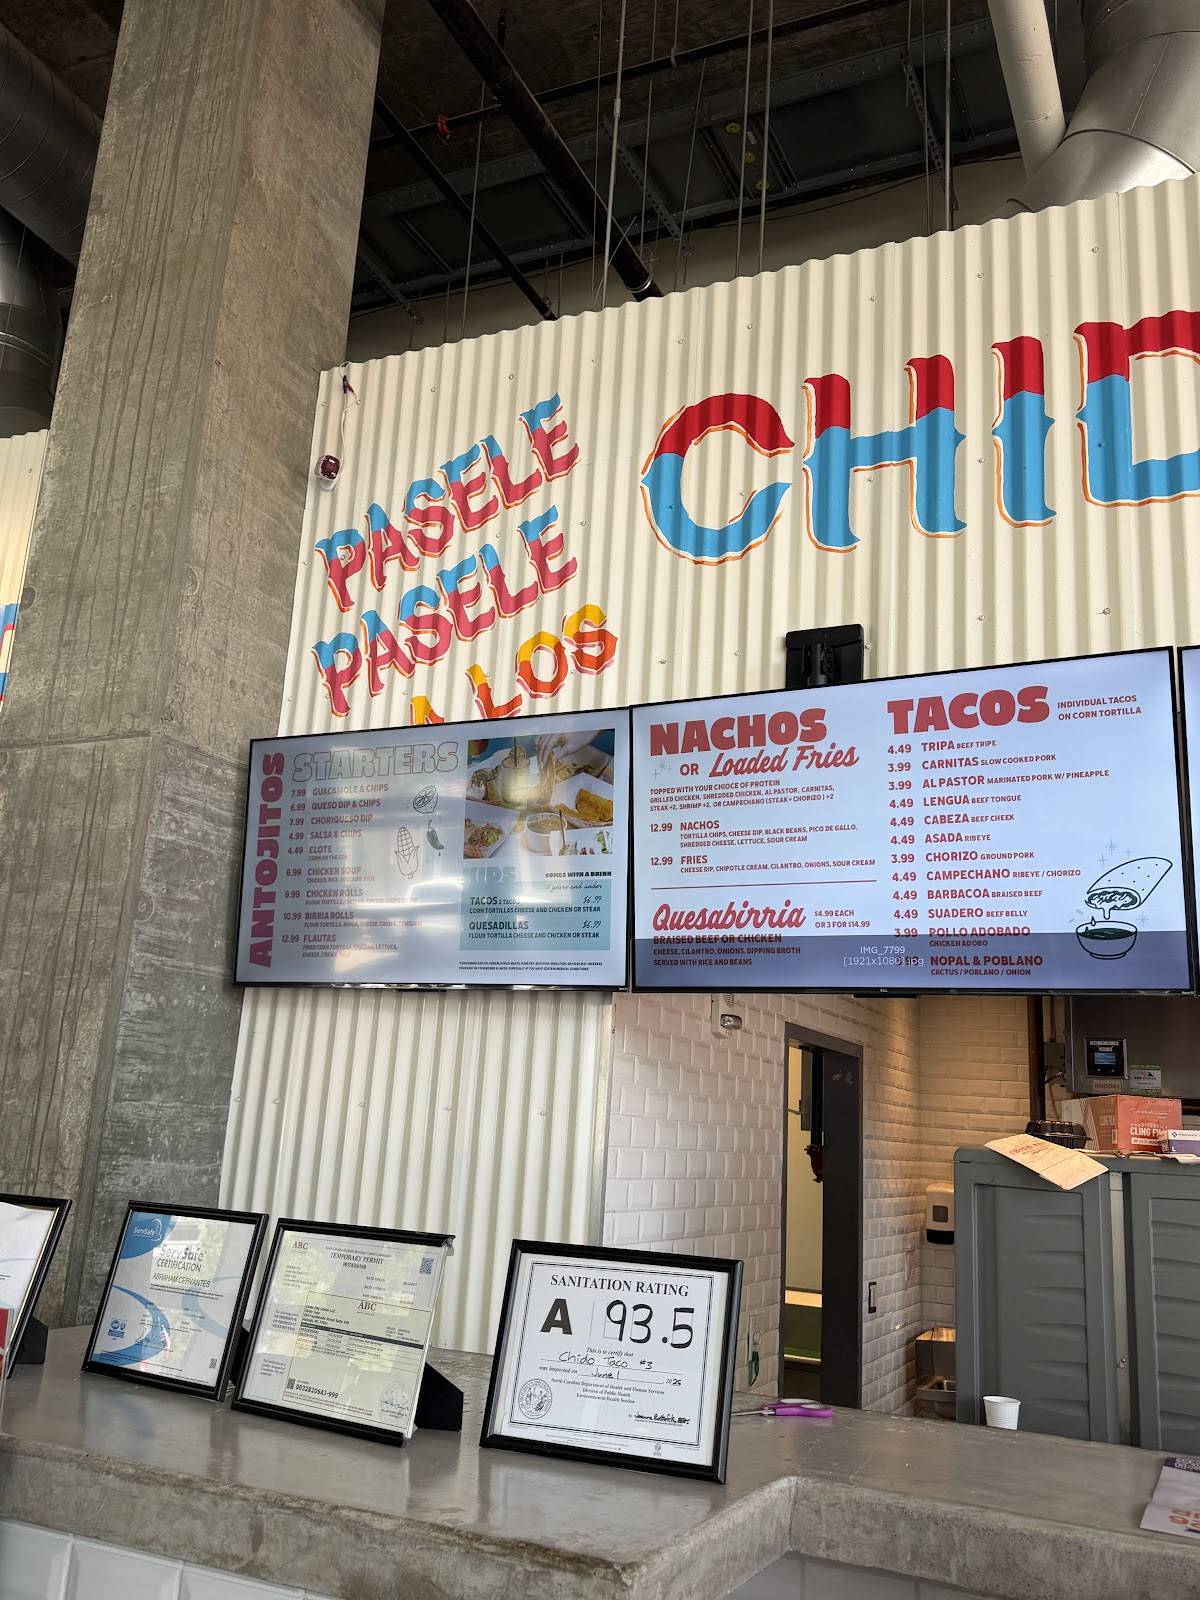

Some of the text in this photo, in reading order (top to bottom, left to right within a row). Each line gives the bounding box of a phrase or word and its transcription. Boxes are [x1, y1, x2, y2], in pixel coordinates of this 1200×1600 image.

[315, 393, 579, 612] PASELE
[311, 505, 577, 717] PASELE
[466, 604, 618, 719] LOS
[1057, 694, 1136, 708] INDIVIDUAL TACOS
[887, 685, 1050, 735] TACOS
[1058, 706, 1141, 720] ON CORN TORTILLA
[650, 708, 827, 756] NACHOS
[887, 743, 911, 754] 4.49
[922, 740, 954, 751] TRIPA
[292, 741, 459, 782] STARTERS
[680, 743, 859, 777] OR Loaded Fries
[887, 761, 911, 772] 3.99
[921, 756, 978, 770] CARNITAS
[1002, 755, 1034, 764] COOKED
[1034, 753, 1056, 761] PORK
[888, 780, 911, 790] 3.99
[922, 778, 936, 788] AL
[938, 774, 984, 787] PASTOR
[986, 775, 1030, 784] MARINATED
[1065, 769, 1109, 778] PINEAPPLE
[366, 784, 388, 792] CHIPS
[650, 787, 675, 795] TOPPED
[749, 779, 780, 788] PROTEIN
[312, 802, 337, 810] QUESO
[359, 799, 380, 807] CHIPS
[889, 798, 913, 808] 4.49
[923, 794, 969, 806] LENGUA
[990, 794, 1021, 802] TONGUE
[311, 815, 359, 825] CHORIQUESO
[360, 814, 373, 822] DIP
[650, 820, 719, 832] 12.99 NACHOS
[890, 816, 914, 826] 4.49
[924, 813, 969, 825] CABEZA
[890, 834, 915, 844] 4.49
[924, 832, 962, 843] ASADA
[249, 752, 285, 968] ANTOJITOS
[650, 854, 707, 866] 12.99 FRIES
[891, 853, 914, 863] 3.99
[925, 850, 978, 862] CHORIZO
[892, 871, 916, 882] 4.49
[926, 868, 1010, 880] CAMPECHANO
[582, 896, 602, 904] $6.99
[892, 890, 917, 900] 4.49
[927, 887, 989, 899] BARBACOA
[470, 897, 497, 905] TACOS
[653, 899, 806, 931] Quesabirria
[893, 909, 918, 919] 4.49
[927, 907, 983, 918] SUADERO
[469, 921, 529, 930] QUESADILLAS
[582, 920, 602, 929] $6.99
[894, 926, 1030, 938] 3.99 POLLO ADOBADO
[653, 934, 782, 944] BRAISED BEEF OR CHICKEN
[860, 946, 906, 956] IMG_7799
[930, 955, 970, 965] NOPAL
[983, 955, 1043, 965] POBLANO
[1130, 1126, 1150, 1136] CLING
[134, 1227, 156, 1235] ServSafe
[292, 1241, 309, 1250] ABC
[330, 1253, 384, 1264] TEMPORARY PERMIT
[156, 1259, 202, 1272] CERTIFICATION
[153, 1273, 178, 1283] ABRAHAM
[550, 1274, 689, 1297] SANITATION RATING
[357, 1300, 377, 1312] ABC
[540, 1298, 573, 1335] A
[606, 1299, 695, 1348] 93.5
[559, 1351, 595, 1365] Chido
[604, 1357, 629, 1368] Taco
[592, 1367, 613, 1379] June
